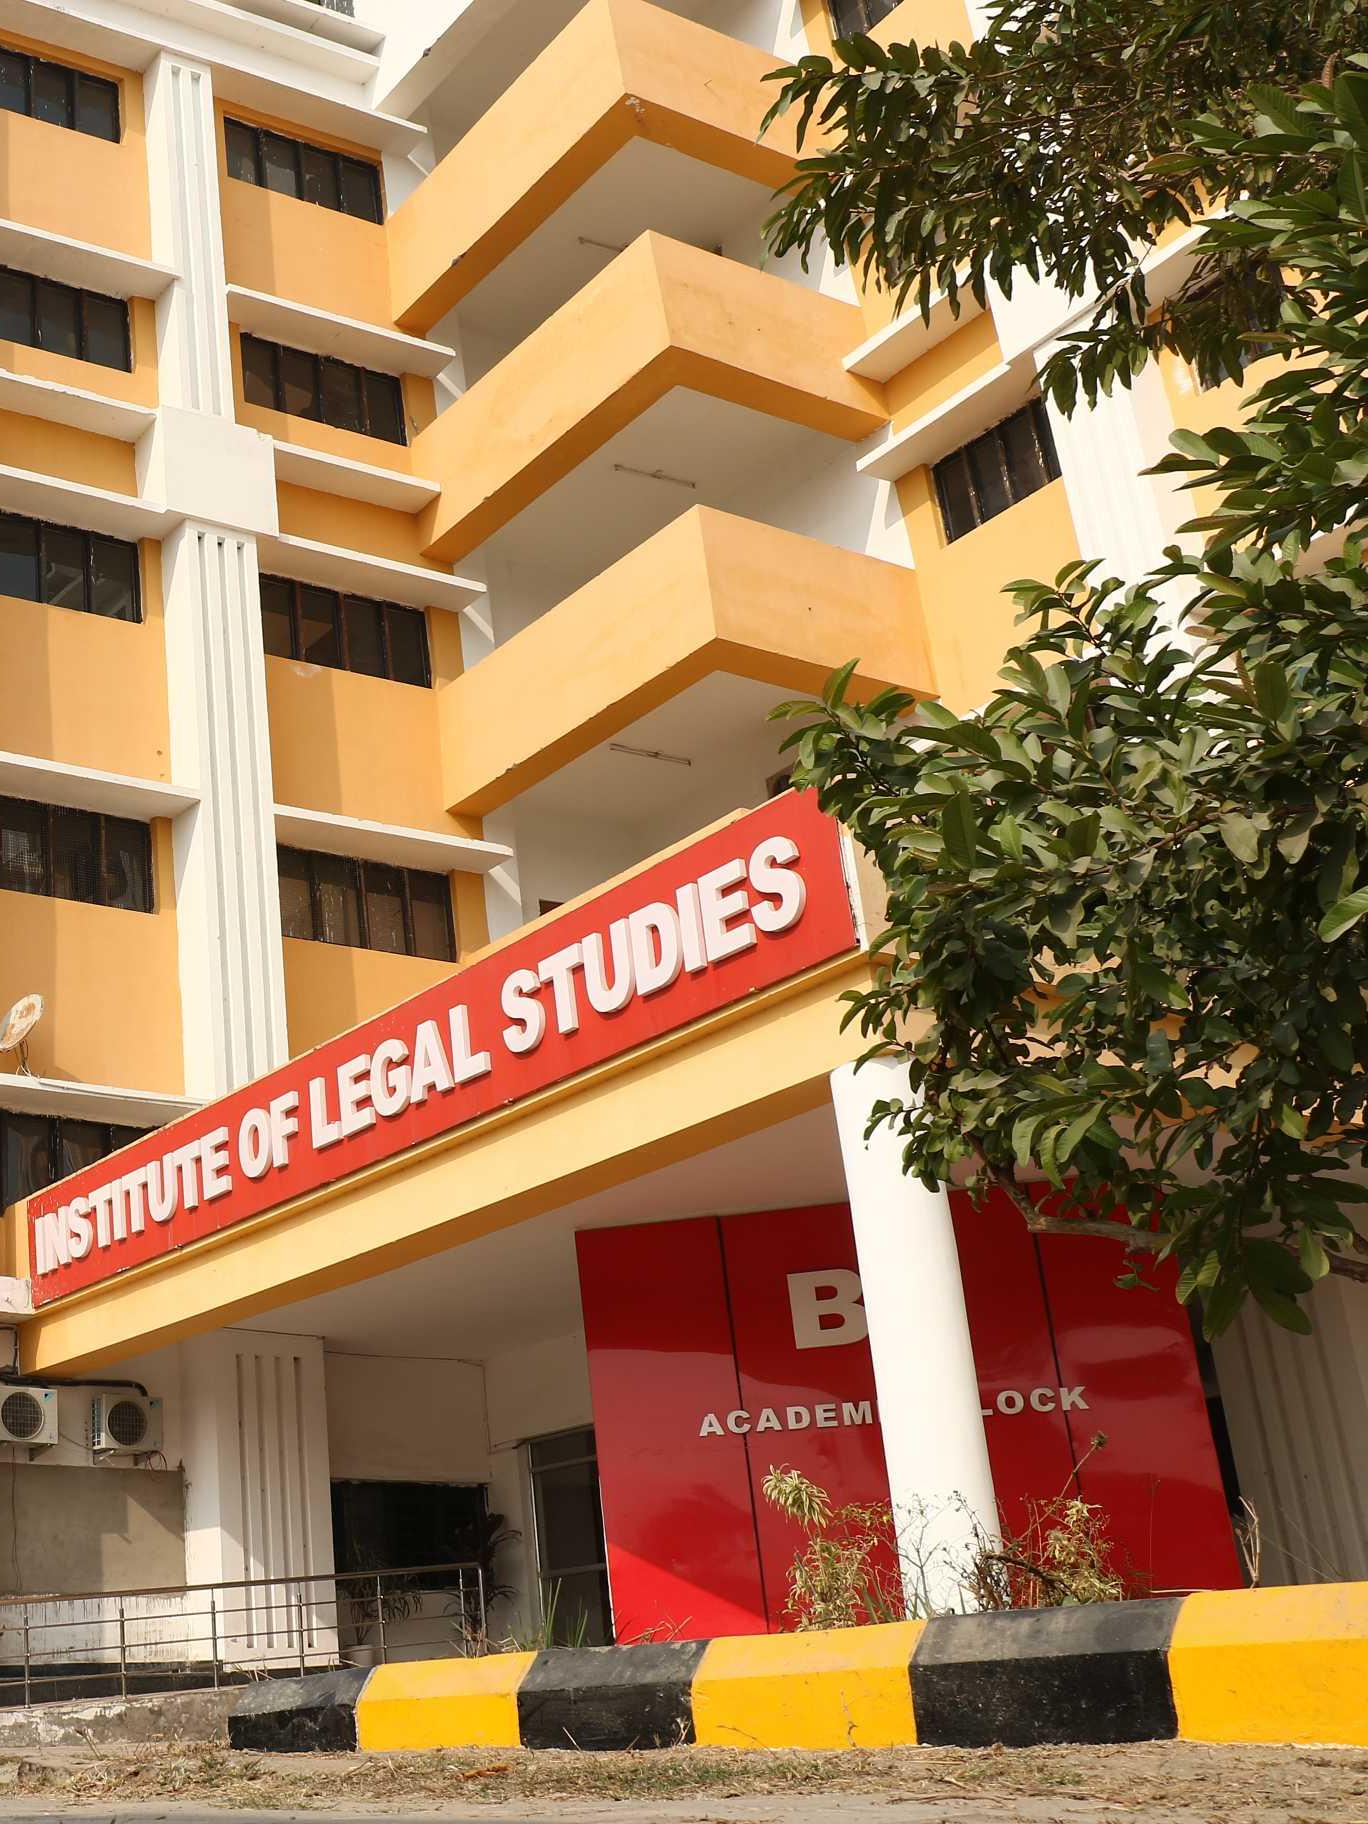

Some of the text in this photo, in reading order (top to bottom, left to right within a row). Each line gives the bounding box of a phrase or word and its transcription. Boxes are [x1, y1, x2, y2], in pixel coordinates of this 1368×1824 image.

[34, 835, 807, 1276] INSTITUTE OF LEGAL STUDIES
[786, 1268, 869, 1350] B
[698, 1400, 873, 1437] ACADEM
